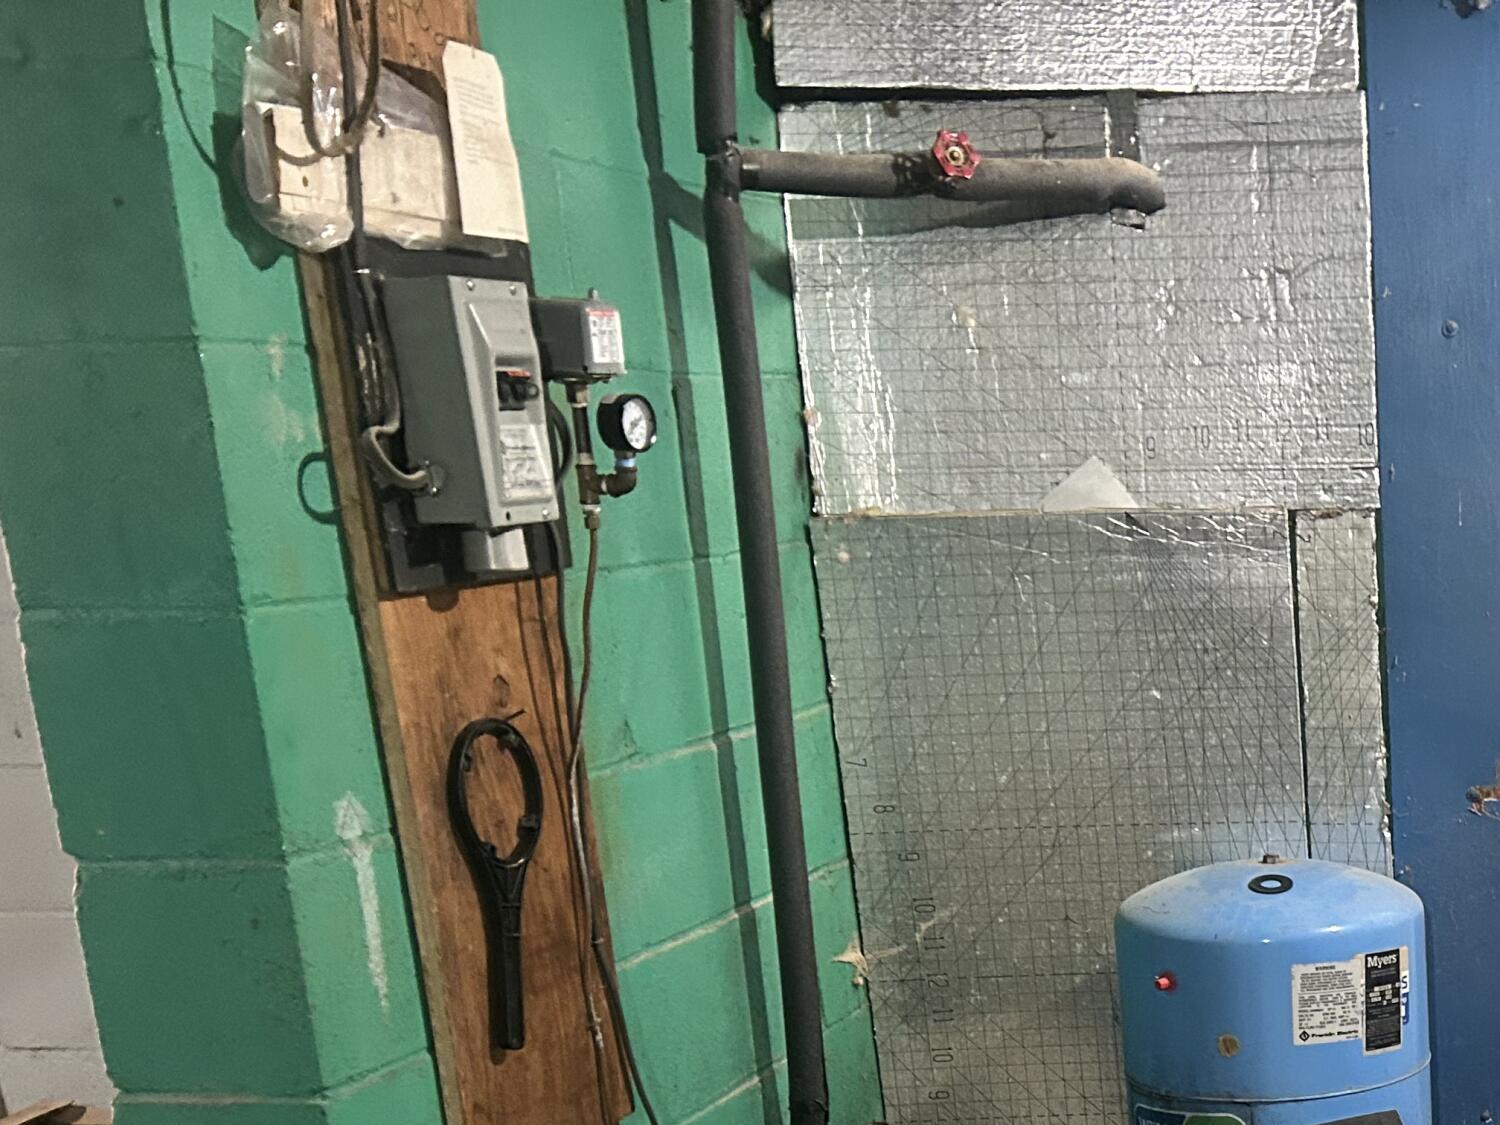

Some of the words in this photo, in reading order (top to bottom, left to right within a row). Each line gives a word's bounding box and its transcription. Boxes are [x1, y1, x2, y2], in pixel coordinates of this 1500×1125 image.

[1193, 425, 1211, 449] 10
[1358, 422, 1374, 447] 10
[845, 758, 867, 767] 7
[873, 805, 895, 814] 8
[898, 852, 919, 861] 9
[912, 897, 936, 913] 10
[923, 936, 946, 950] 11
[1367, 954, 1397, 968] Myers
[926, 973, 949, 988] 12
[932, 1008, 955, 1023] 11
[931, 1046, 954, 1062] 10
[928, 1090, 950, 1100] 9
